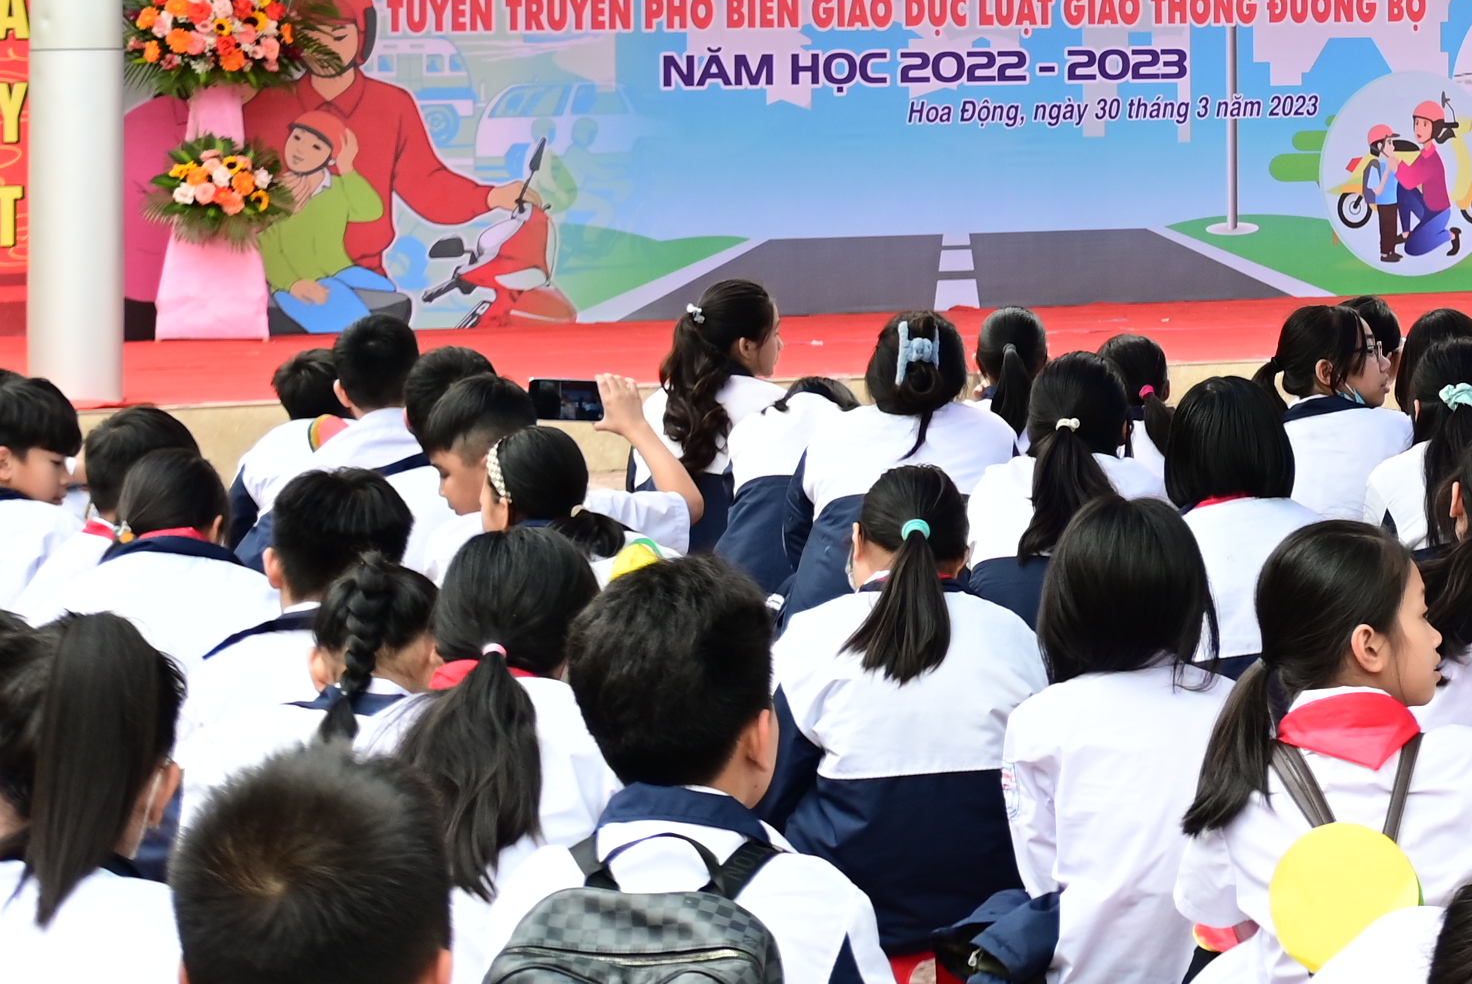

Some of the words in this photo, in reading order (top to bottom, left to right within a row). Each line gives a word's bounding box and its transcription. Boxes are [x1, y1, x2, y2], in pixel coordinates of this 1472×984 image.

[661, 47, 775, 89] NĂM
[790, 52, 889, 93] HỌC
[899, 50, 1027, 84] 2022
[1035, 64, 1056, 74] -
[1066, 47, 1188, 81] 2023
[907, 101, 954, 124] Hoa
[959, 97, 1027, 127] Động,
[1032, 99, 1089, 127] ngày
[1094, 97, 1121, 121] 30
[1127, 94, 1191, 126] tháng
[1196, 96, 1209, 119] 3
[1215, 95, 1263, 119] năm
[1269, 94, 1320, 117] 2023
